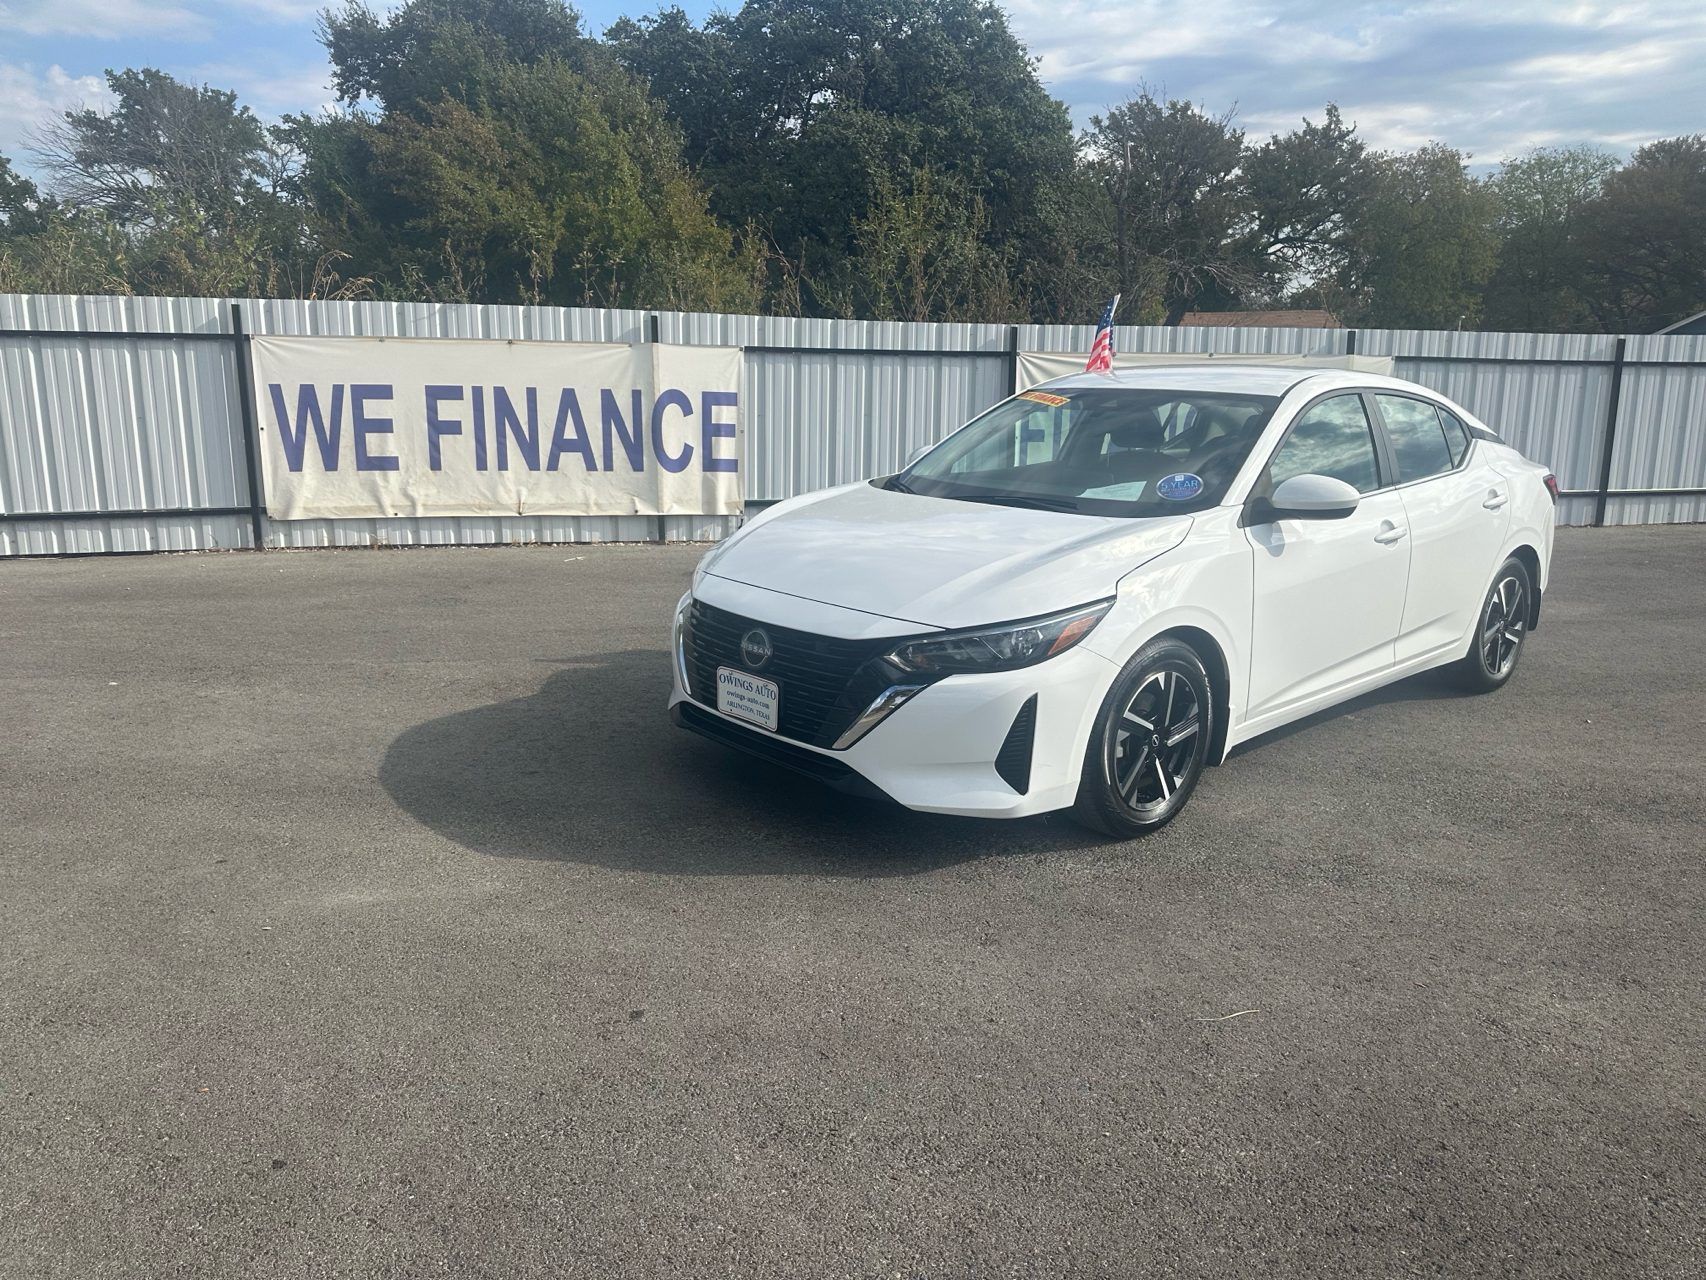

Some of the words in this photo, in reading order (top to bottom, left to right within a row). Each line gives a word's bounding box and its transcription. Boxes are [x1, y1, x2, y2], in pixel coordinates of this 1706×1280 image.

[269, 384, 400, 472] WE
[425, 385, 739, 473] FINANCE
[1171, 480, 1198, 489] YEAR
[719, 673, 753, 692] OWINGS
[755, 685, 776, 701] AUTO
[726, 689, 770, 710] owings-auto.com
